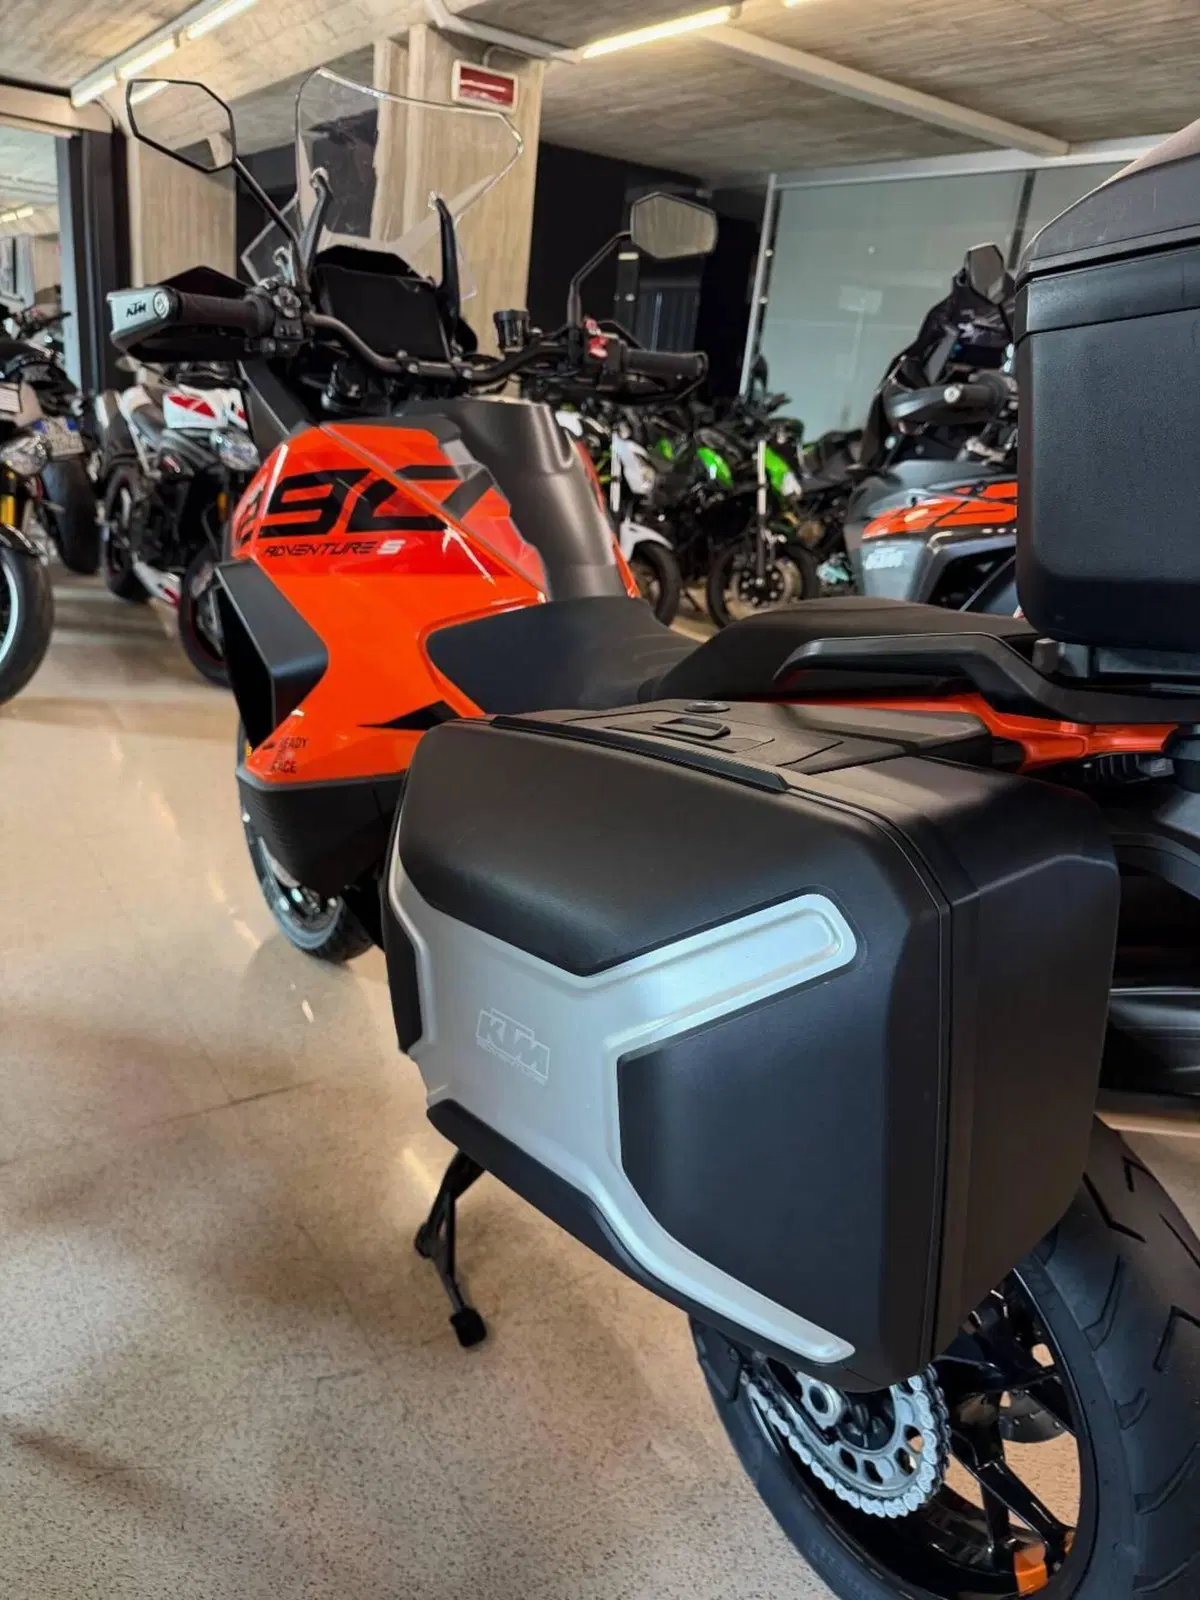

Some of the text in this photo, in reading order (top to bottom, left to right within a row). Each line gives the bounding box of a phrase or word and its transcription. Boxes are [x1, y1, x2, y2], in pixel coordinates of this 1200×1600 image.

[125, 300, 147, 317] KTM
[261, 539, 406, 557] ADVENTURE S
[476, 1007, 550, 1080] KTM
